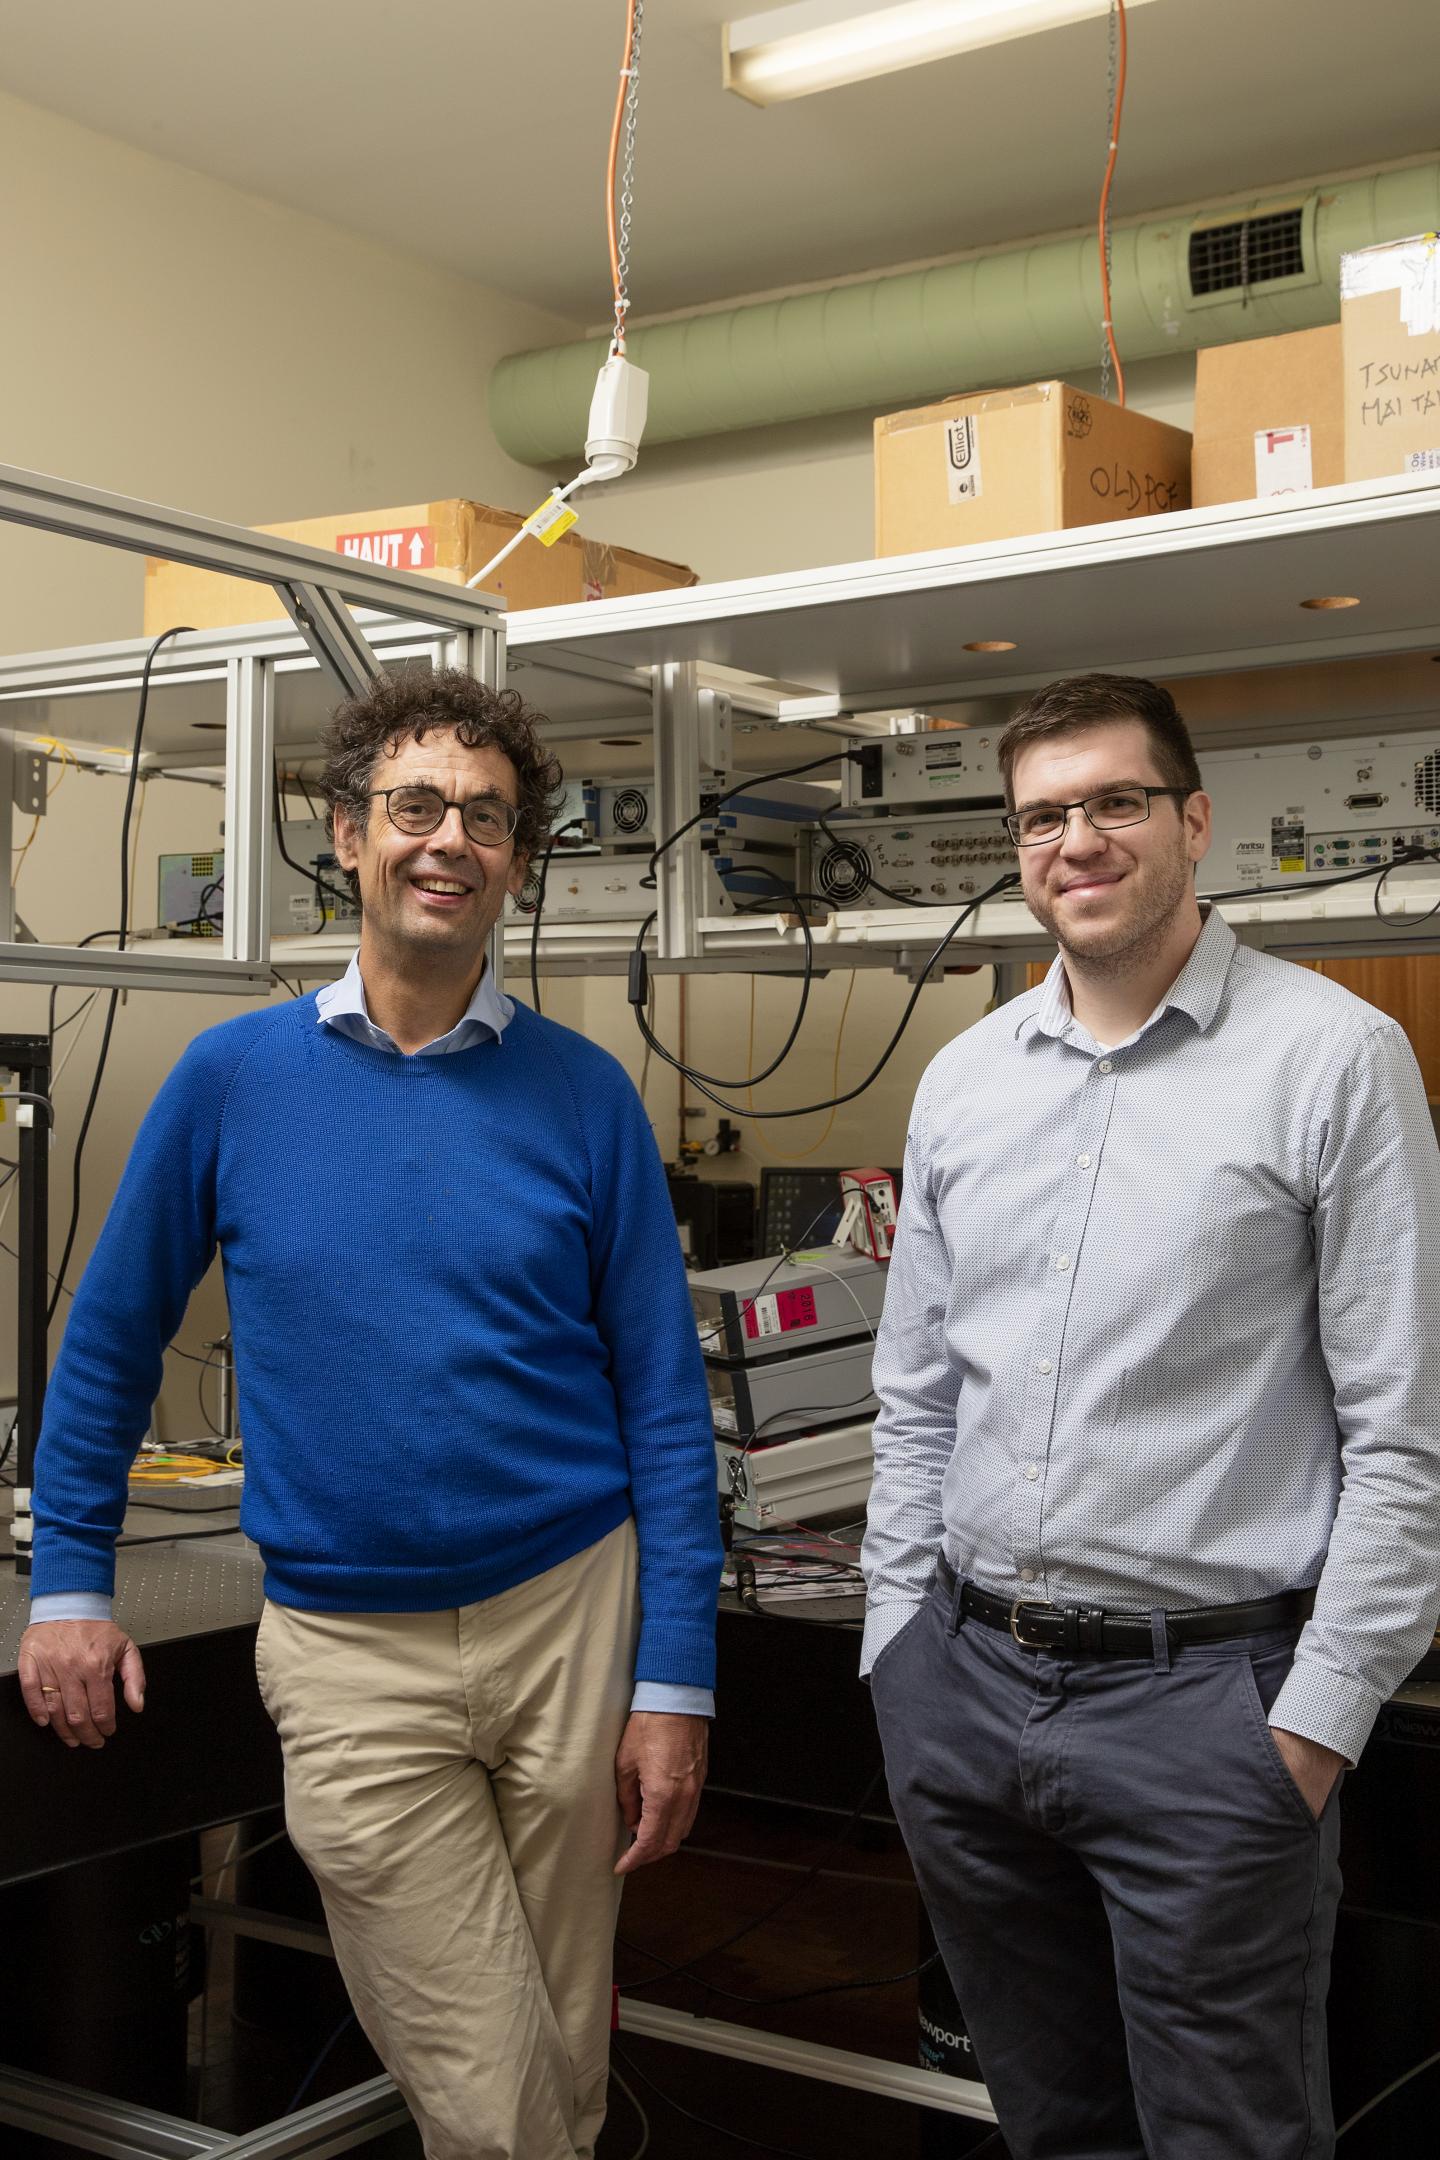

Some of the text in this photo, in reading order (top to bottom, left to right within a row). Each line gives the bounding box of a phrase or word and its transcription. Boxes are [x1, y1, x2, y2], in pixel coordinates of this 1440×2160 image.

[1361, 397, 1402, 427] MAI
[954, 424, 966, 463] Elliot
[1090, 461, 1142, 511] OLD
[343, 533, 404, 568] HAUT
[918, 2005, 972, 2053] ewport
